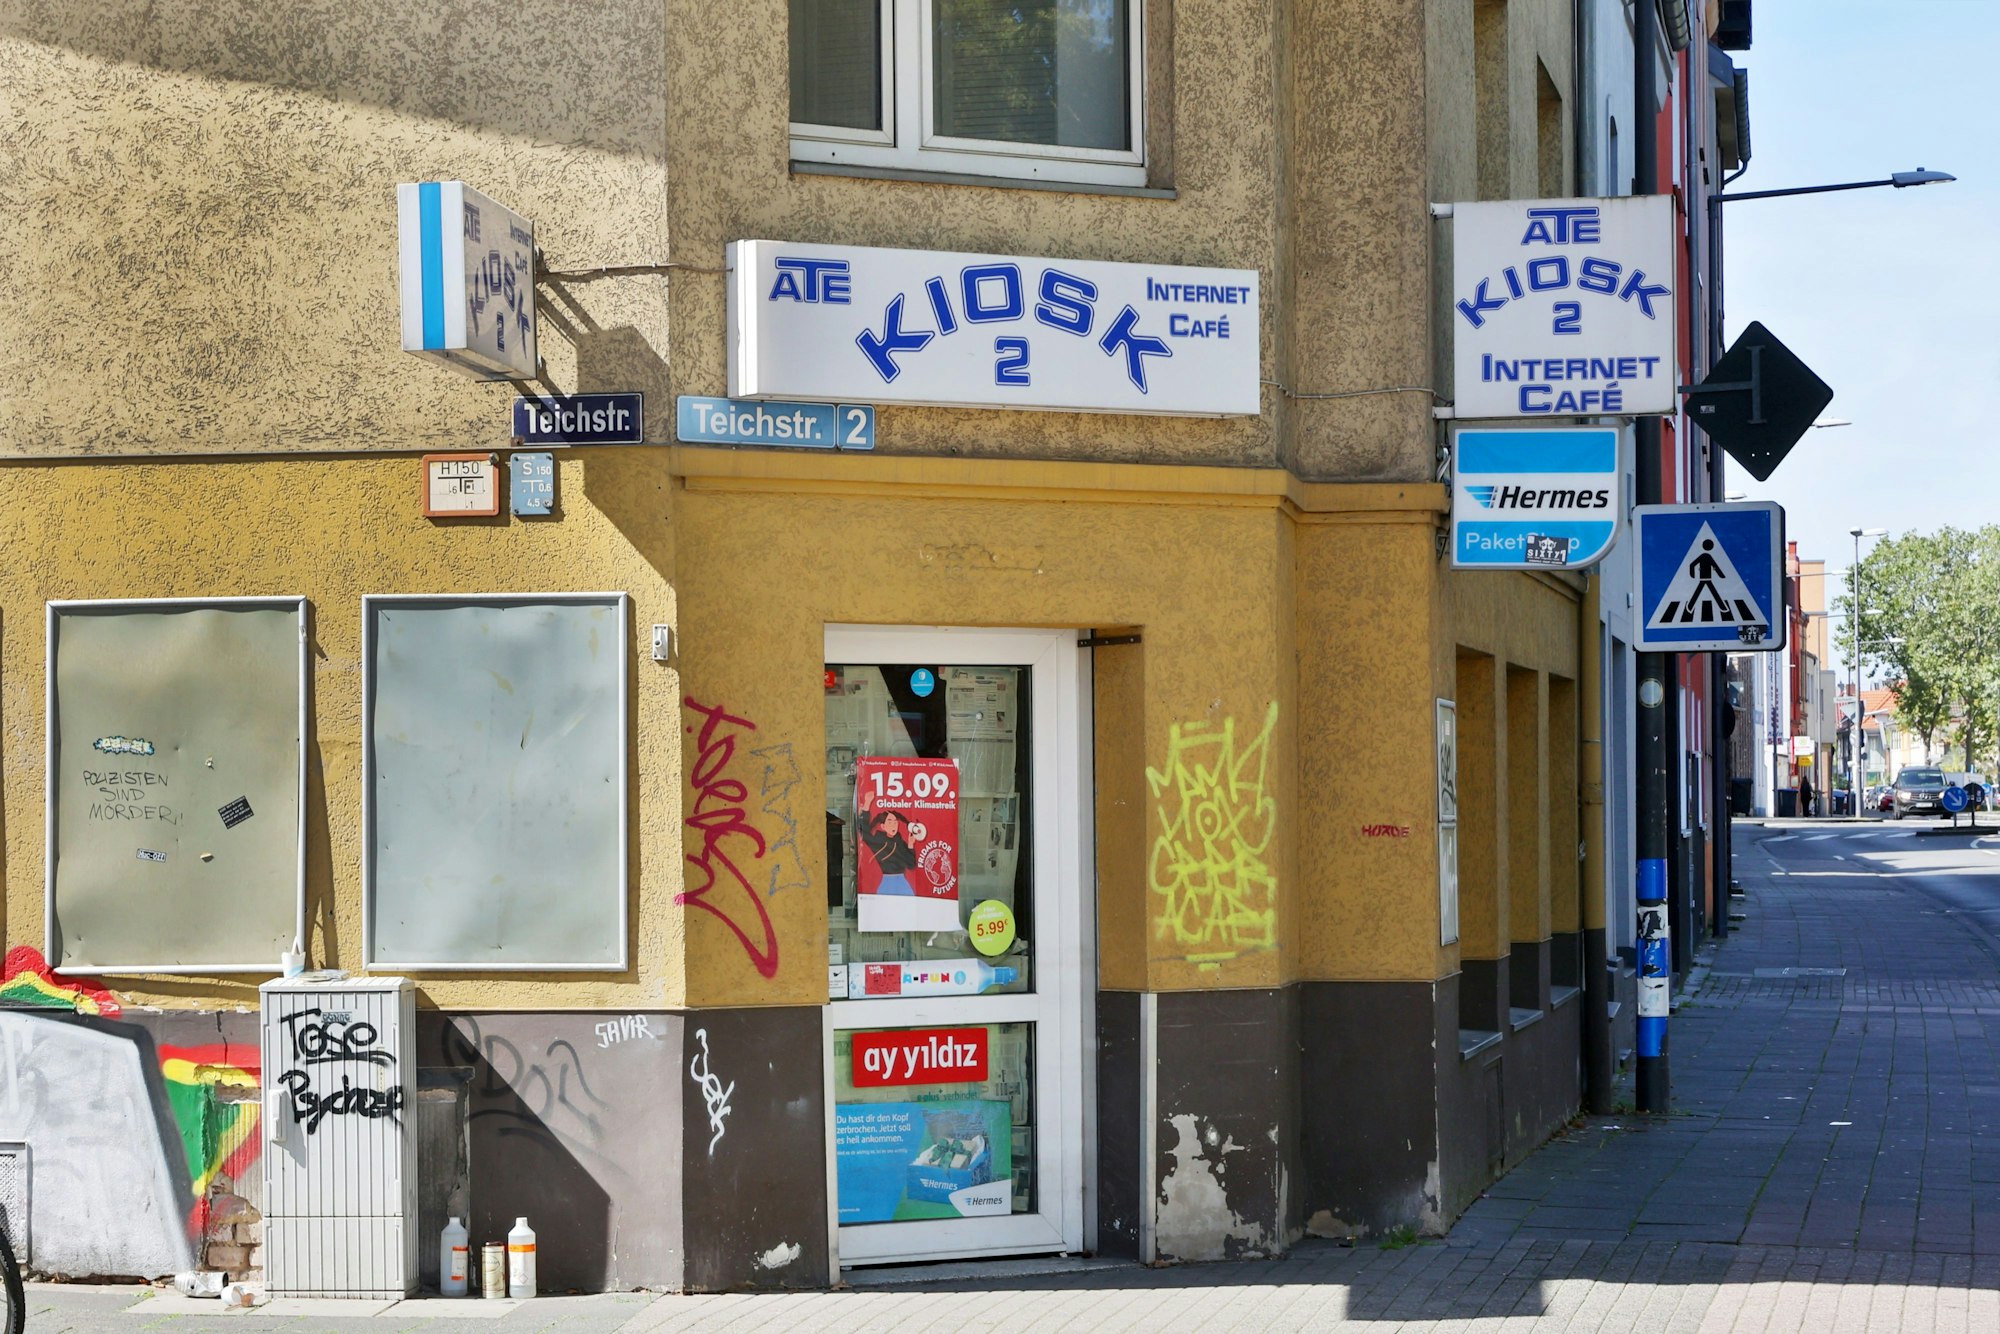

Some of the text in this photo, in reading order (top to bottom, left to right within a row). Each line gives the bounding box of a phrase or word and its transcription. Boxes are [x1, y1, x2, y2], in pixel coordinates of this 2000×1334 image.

[1520, 206, 1601, 245] ATE
[769, 256, 852, 305] ATE
[1146, 276, 1251, 305] INTERNET
[1456, 255, 1672, 329] KIOSK
[855, 262, 1173, 395] KIOSK
[1168, 312, 1231, 339] CAFÉ
[1552, 300, 1582, 336] 2
[994, 335, 1031, 387] 2
[1481, 352, 1661, 382] INTERNET
[1518, 382, 1624, 414] CAFÉ
[524, 402, 630, 434] Teichstr.
[692, 403, 867, 445] Teichstr. 2
[522, 461, 552, 476] S 150
[1498, 485, 1610, 509] Hermes
[99, 786, 145, 802] SIND
[870, 771, 956, 800] 15.09.
[876, 799, 956, 810] Globaler Klimastreik
[917, 840, 952, 868] FRIDAYS FOR
[932, 875, 957, 895] FUTURE
[864, 1046, 898, 1080] ay
[836, 1123, 912, 1134] zerbrochen. Jetzt soll
[848, 1114, 864, 1124] hast
[865, 1113, 876, 1123] dir
[876, 1113, 891, 1122] den
[892, 1112, 909, 1124] Kopf
[861, 1134, 904, 1144] ankommen.
[928, 1179, 959, 1191] Hermes
[972, 1196, 1004, 1206] Hermes
